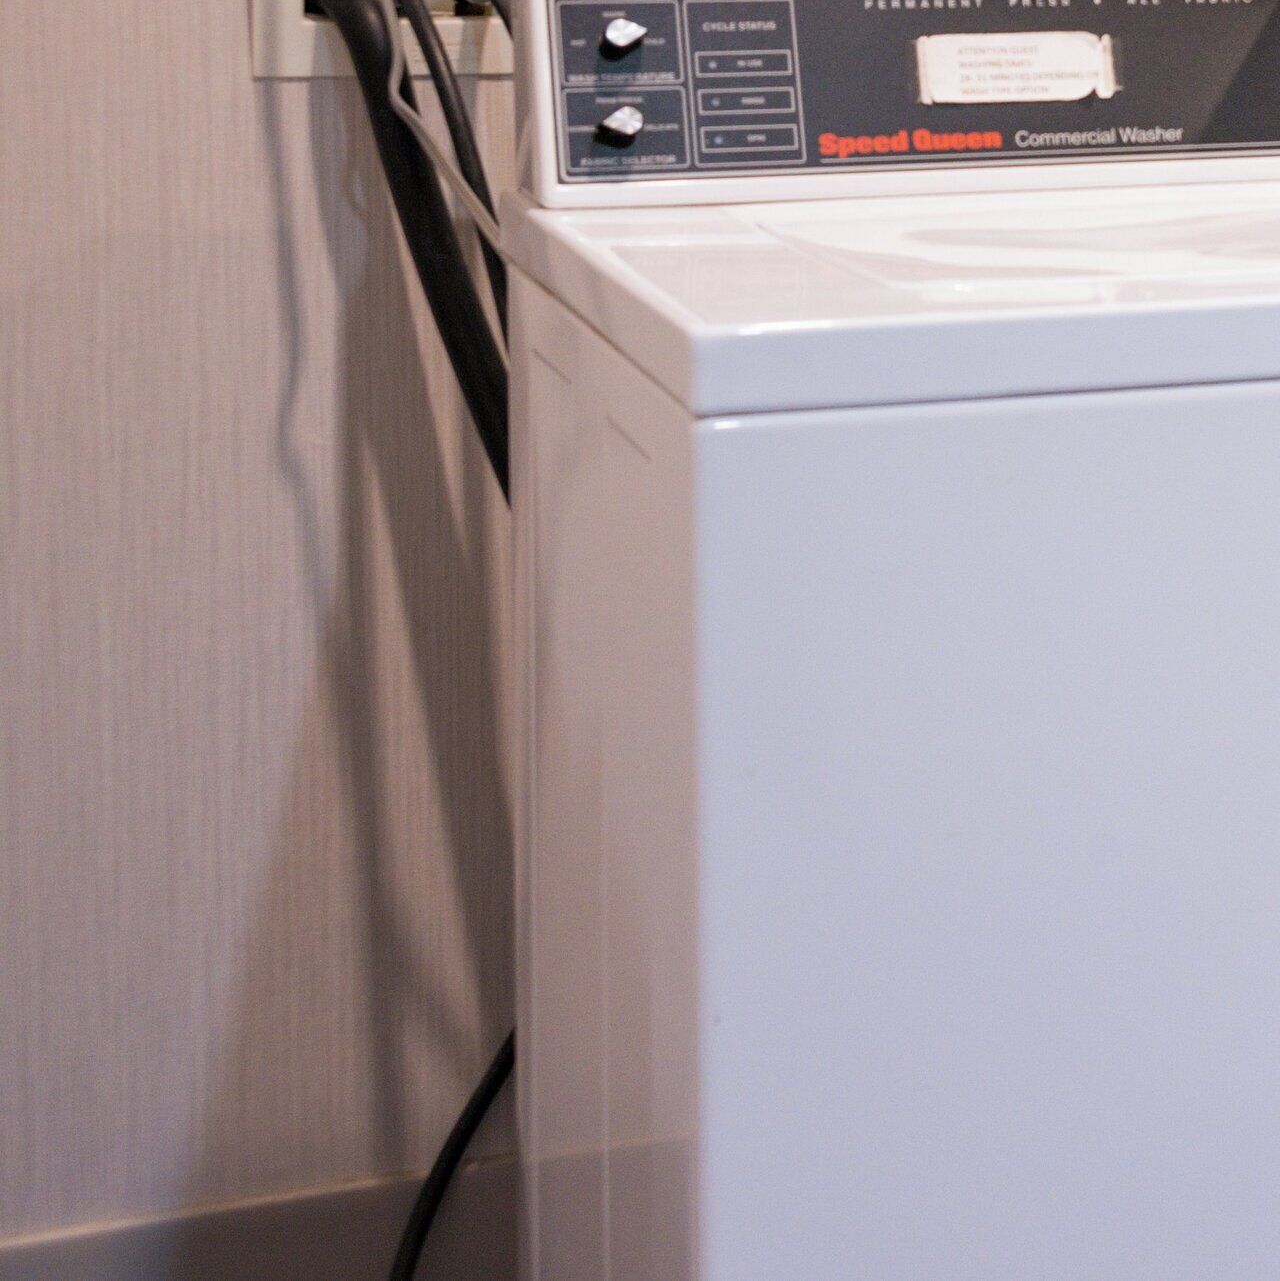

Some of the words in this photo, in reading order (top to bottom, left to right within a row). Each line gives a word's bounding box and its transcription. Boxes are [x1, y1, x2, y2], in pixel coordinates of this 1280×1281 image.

[702, 21, 737, 32] CYCLE
[738, 20, 777, 31] STATUS
[818, 130, 908, 157] Speed
[912, 129, 1002, 151] Queen
[1015, 128, 1117, 149] Commercial
[1119, 126, 1184, 144] Washer
